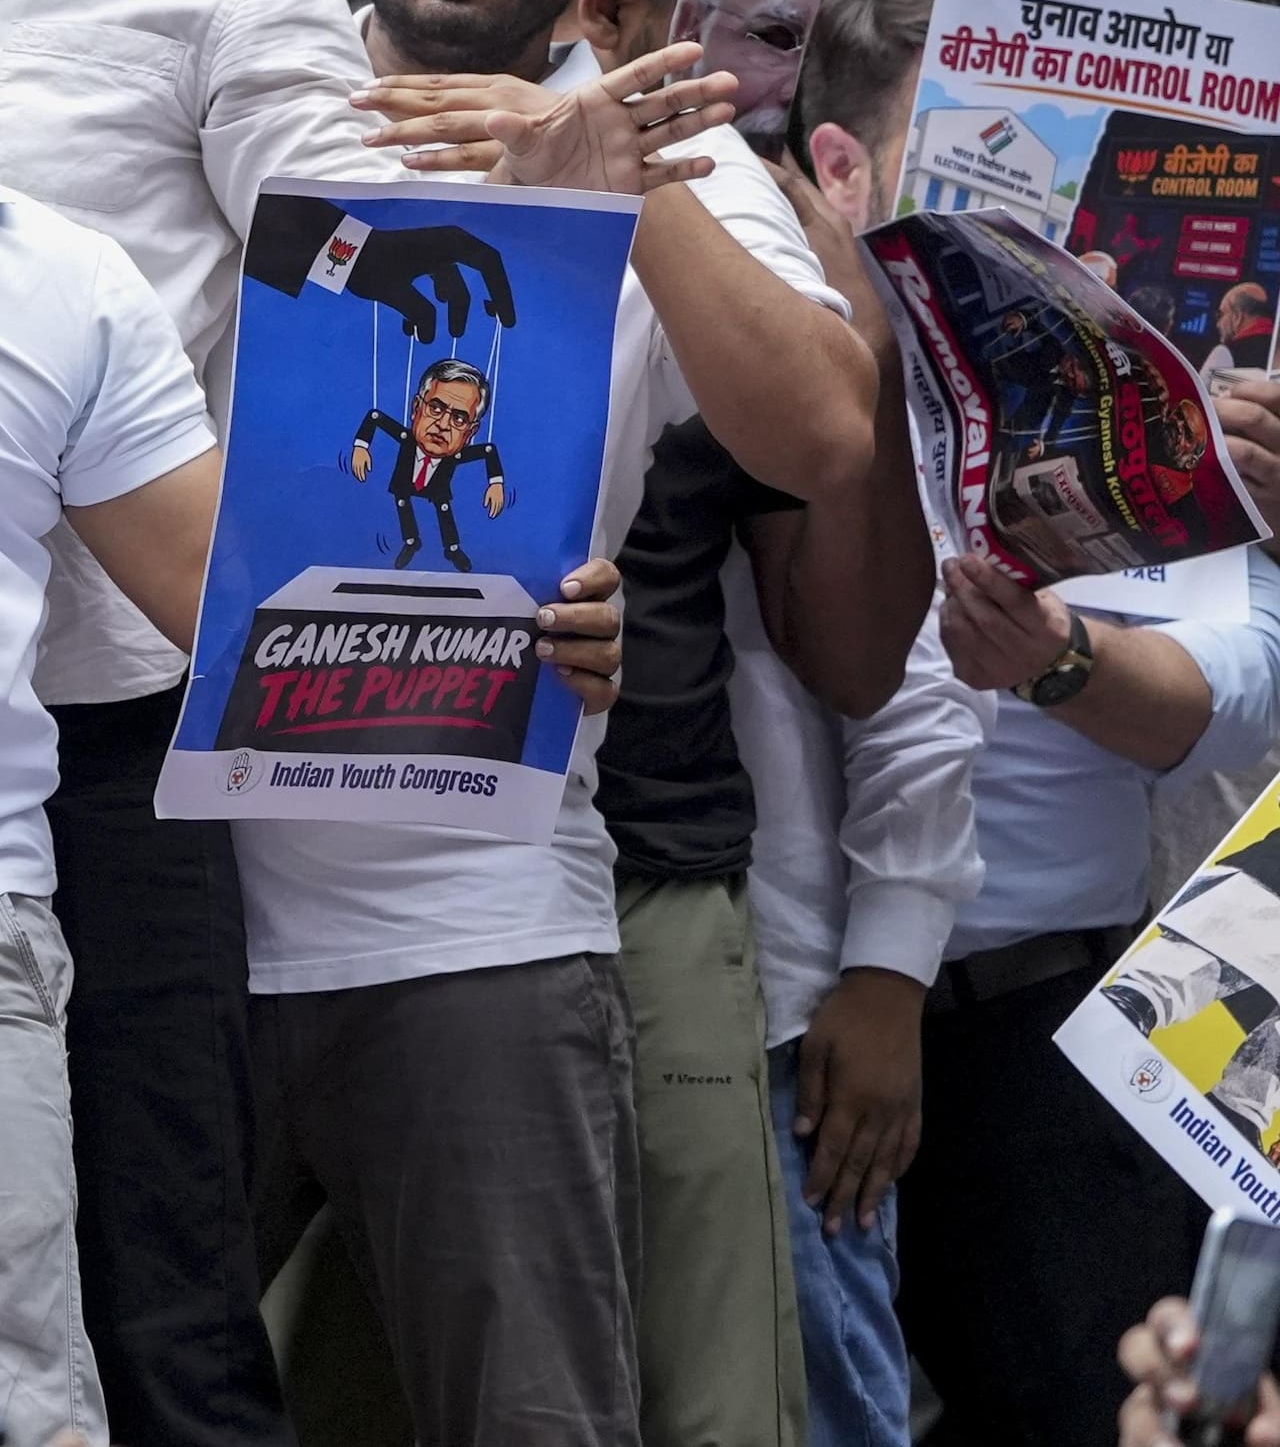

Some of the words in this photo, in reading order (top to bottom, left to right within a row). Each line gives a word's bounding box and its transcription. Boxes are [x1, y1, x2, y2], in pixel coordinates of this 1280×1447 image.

[1107, 7, 1201, 61] आयोग
[1205, 33, 1234, 67] या
[940, 25, 1029, 78] बीजेपी
[1033, 46, 1073, 84] का
[1075, 52, 1192, 105] CONTROL
[1200, 67, 1280, 124] ROOM
[933, 153, 971, 174] ELECTION
[1151, 176, 1212, 197] CONTROL
[1215, 177, 1260, 198] ROOM
[1163, 143, 1229, 176] बीजेपी
[1233, 153, 1260, 175] का
[886, 256, 990, 469] Removal
[1105, 340, 1132, 377] की
[1097, 394, 1117, 474] Gyanesh
[1106, 474, 1140, 532] Kumar
[253, 622, 411, 669] GANESH
[410, 623, 532, 670] KUMAR
[255, 667, 354, 731] THE
[352, 665, 518, 717] PUPPET
[269, 761, 336, 789] Indian
[339, 763, 397, 791] Youth
[399, 763, 499, 798] Congress
[1169, 1096, 1233, 1169] Indian
